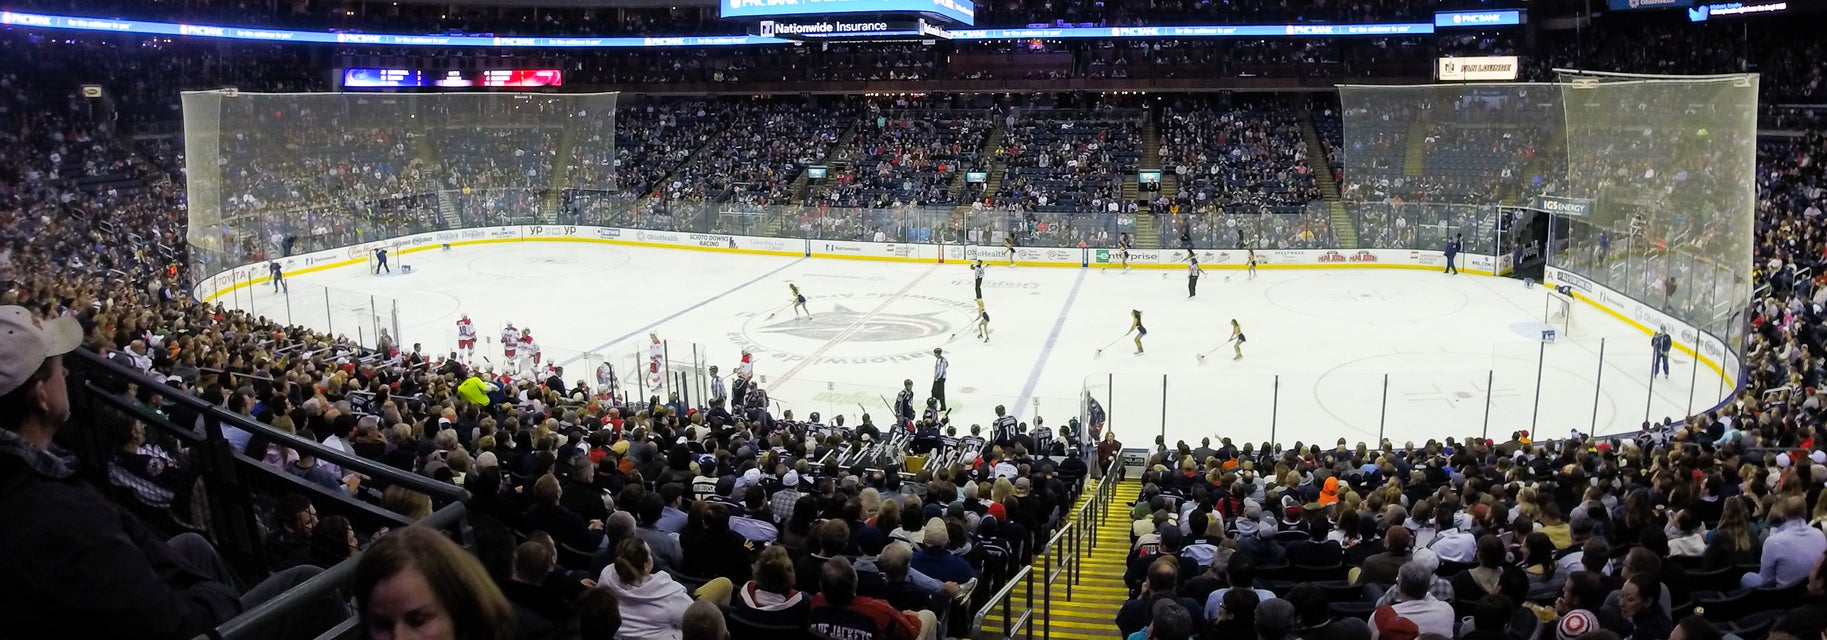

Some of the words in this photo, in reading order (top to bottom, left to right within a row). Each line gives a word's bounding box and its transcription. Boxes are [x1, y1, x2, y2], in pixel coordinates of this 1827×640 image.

[775, 22, 834, 34] Nationwide
[836, 21, 888, 32] Insurance
[1460, 64, 1477, 73] FAN
[1477, 64, 1512, 72] LOUNGE
[1543, 200, 1558, 210] IGS
[1558, 203, 1585, 213] ENERGY
[530, 225, 543, 236] yp
[564, 225, 577, 236] yp
[699, 240, 720, 248] RACINO
[1100, 251, 1158, 261] entprise
[218, 270, 247, 286] TOYOTA
[1005, 424, 1016, 441] 19
[829, 625, 873, 640] JACKETS
